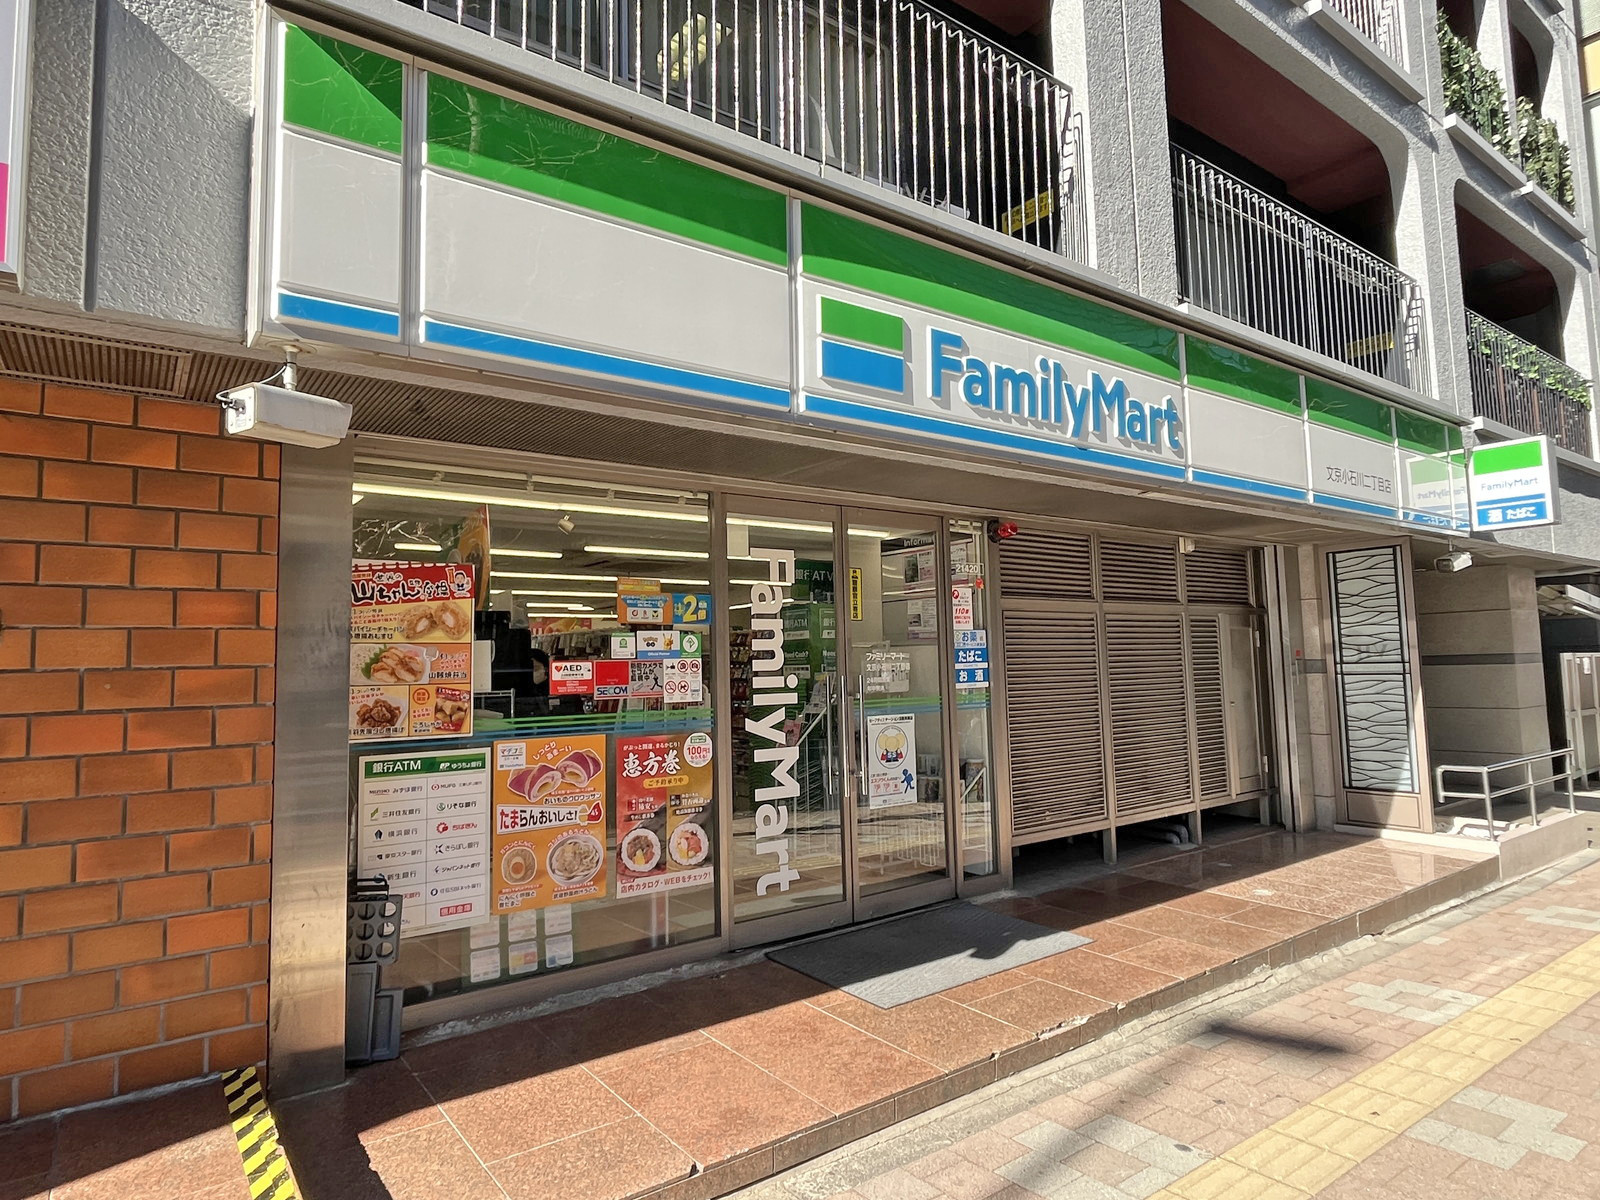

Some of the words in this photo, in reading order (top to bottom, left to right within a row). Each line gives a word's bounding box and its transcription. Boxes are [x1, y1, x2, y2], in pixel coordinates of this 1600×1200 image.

[927, 325, 1181, 450] FamilyMart
[1326, 466, 1392, 494] 文京小石川二丁目店
[1480, 477, 1538, 491] FamilyMart
[351, 580, 421, 603] 山ちゃん
[958, 650, 983, 662] たばこ
[563, 664, 582, 672] AED
[596, 686, 628, 696] SECOM
[745, 547, 801, 896] FamilyMart
[533, 741, 556, 760] しっとり
[372, 760, 421, 773] 銀行ATM
[451, 760, 482, 770] ゆうちょ銀行
[622, 749, 681, 778] 恵方巻
[544, 793, 601, 805] おいものクロワッサン
[447, 801, 477, 810] りそな銀行
[382, 808, 421, 818] 三井住友銀行
[500, 804, 578, 830] たまらんおいしさ!
[388, 828, 418, 838] 横浜銀行
[387, 870, 417, 881] 新生銀行
